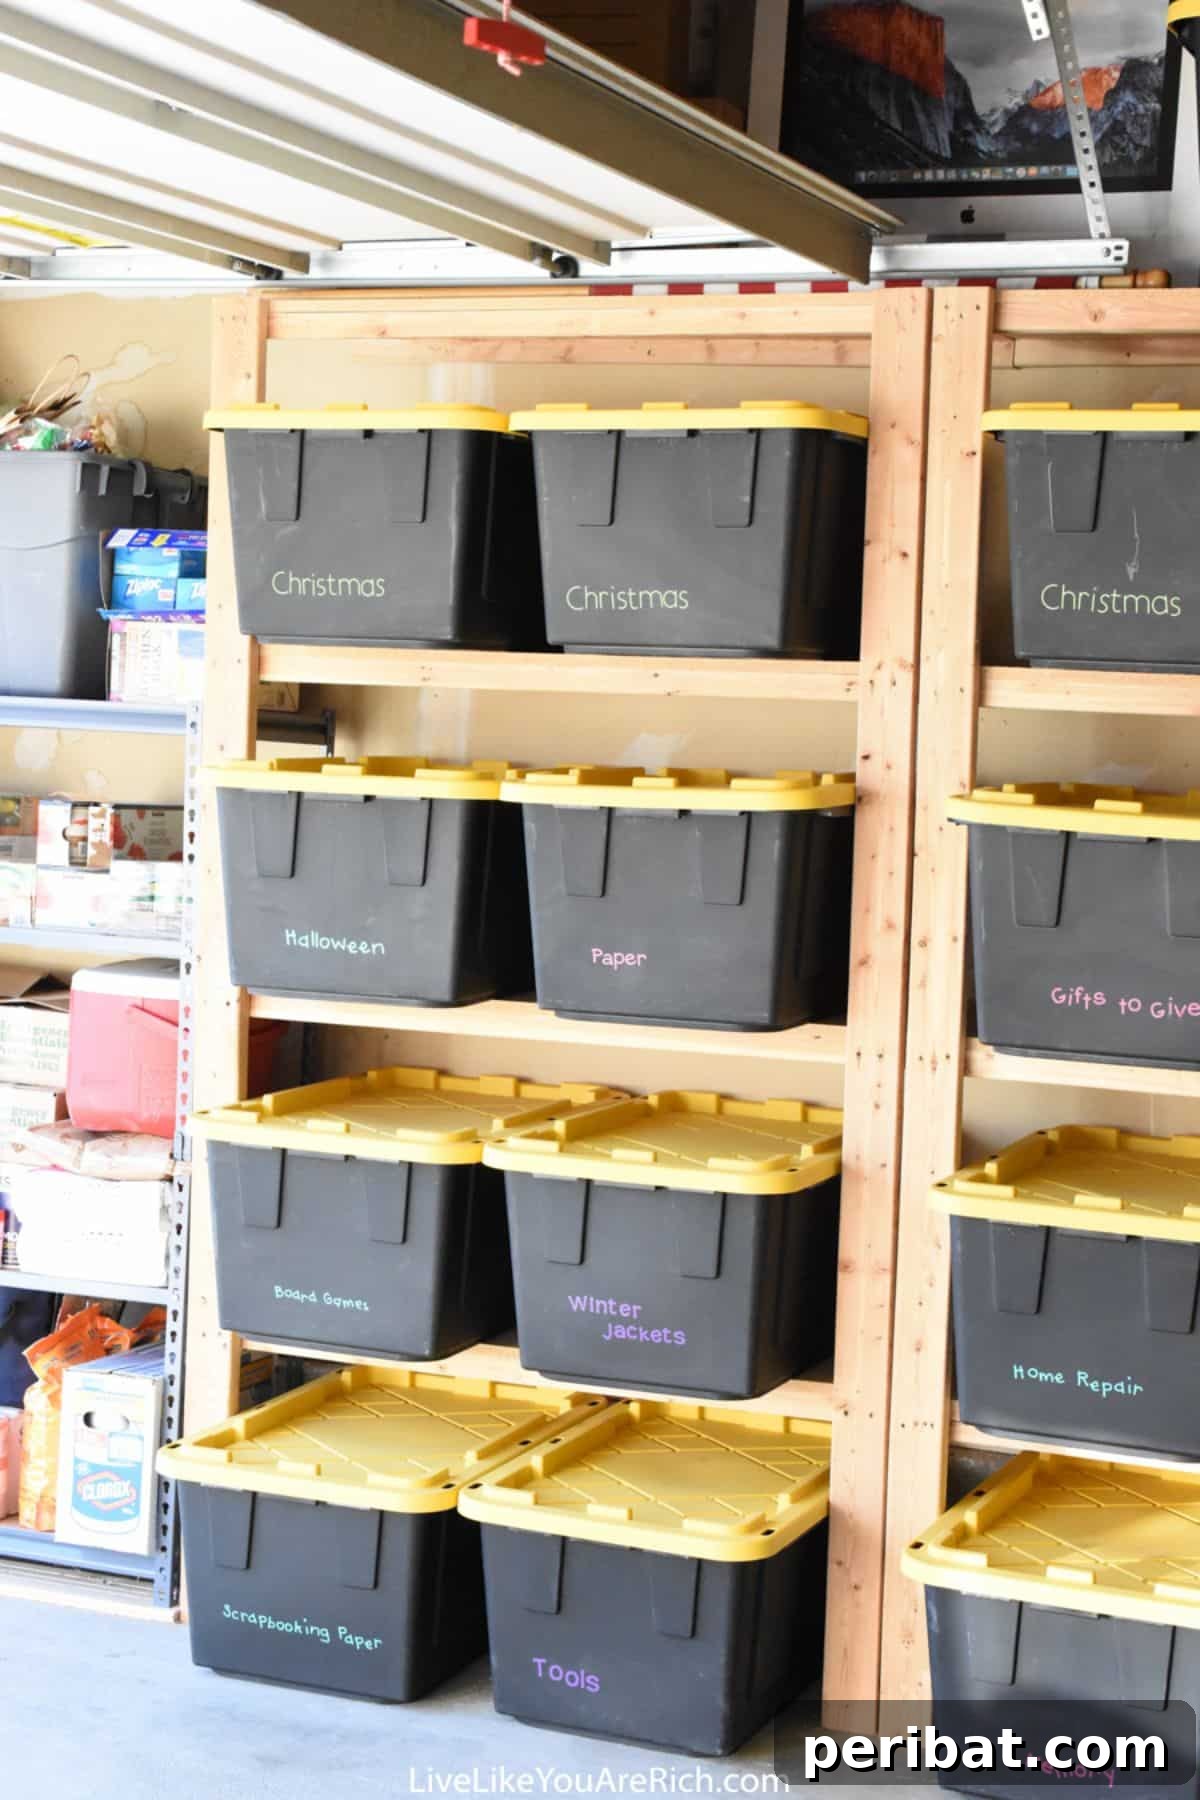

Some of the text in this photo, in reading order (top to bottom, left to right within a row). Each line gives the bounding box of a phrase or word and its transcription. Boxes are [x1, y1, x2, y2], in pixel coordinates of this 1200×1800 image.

[271, 570, 386, 599] Christmas
[565, 584, 690, 612] Christmas
[1040, 583, 1182, 617] Christmas
[285, 928, 386, 957] Halloween
[591, 947, 647, 971] Paper
[1050, 986, 1200, 1019] Gifts to Give
[273, 1285, 370, 1312] Board Games
[567, 1295, 643, 1319] Winter
[601, 1322, 687, 1346] Jackets
[1012, 1363, 1144, 1399] Home Repair
[82, 1479, 133, 1500] CLOROX
[222, 1603, 383, 1650] Scrapbooking Paper
[532, 1656, 601, 1693] Tools
